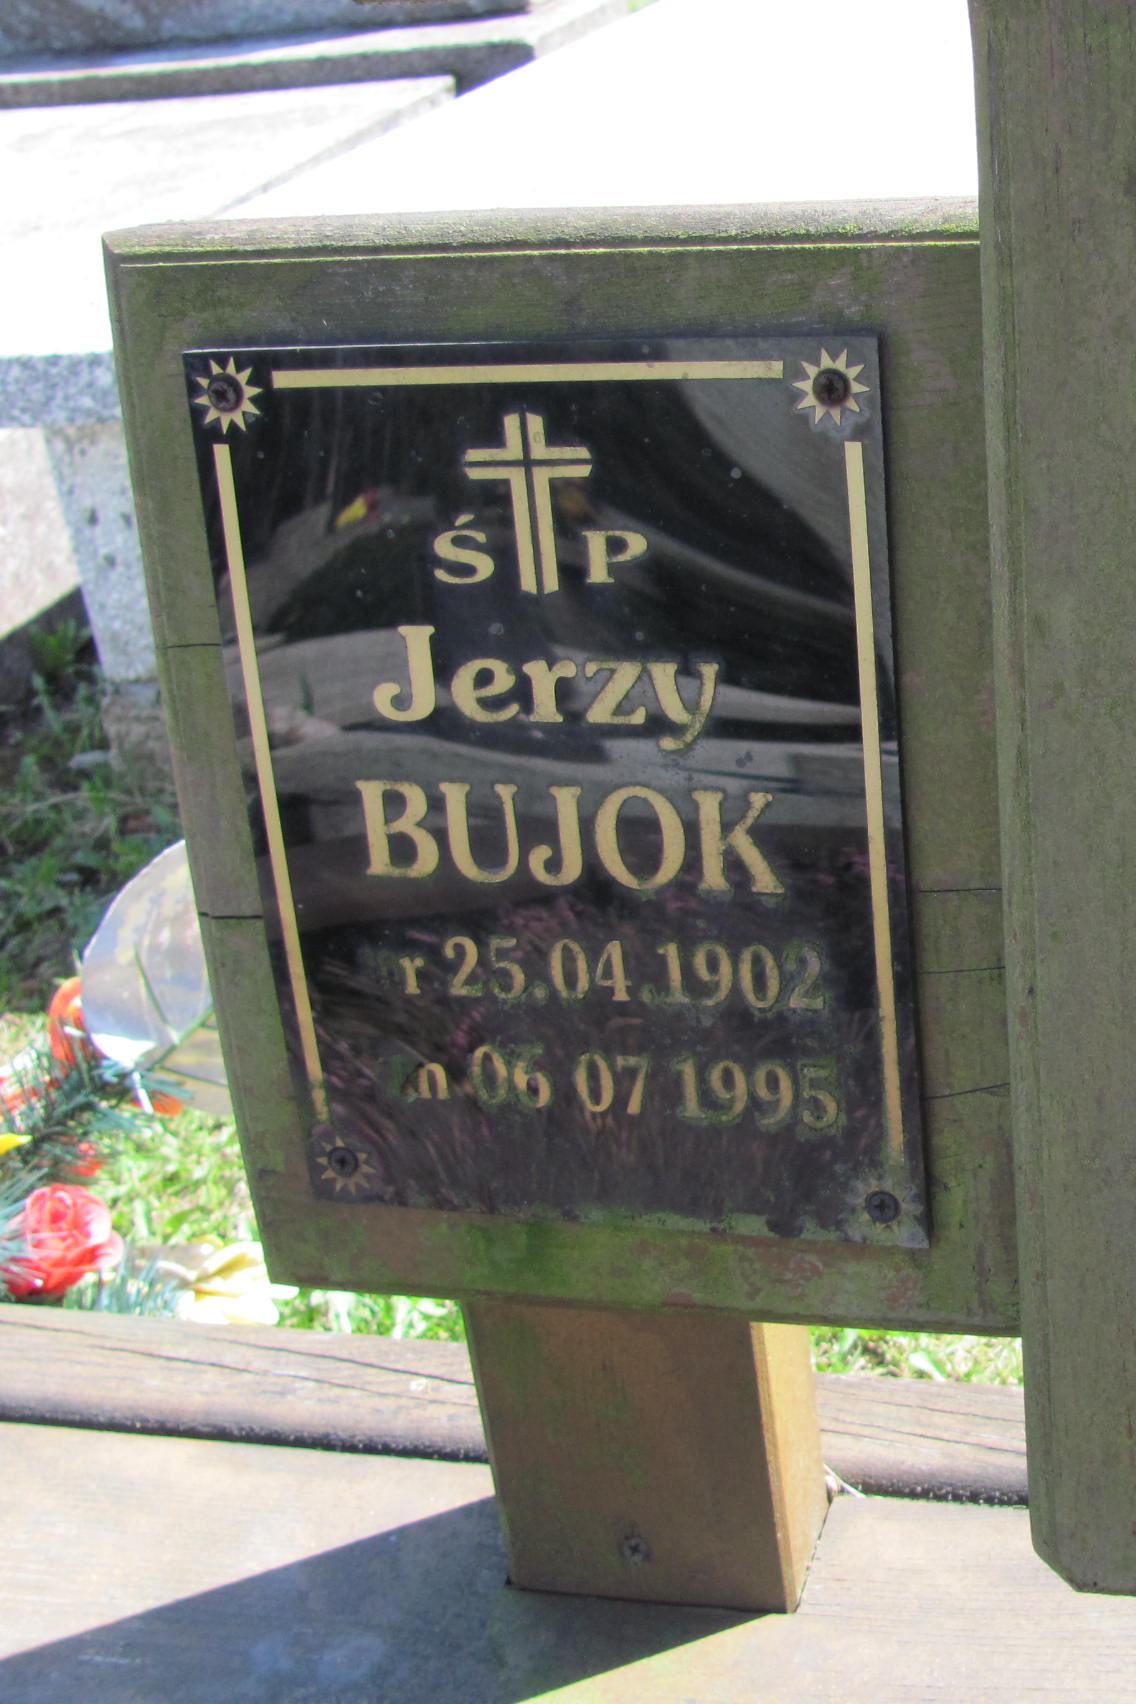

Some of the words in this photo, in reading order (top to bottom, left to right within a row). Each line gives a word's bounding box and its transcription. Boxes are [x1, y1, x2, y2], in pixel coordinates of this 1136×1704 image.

[433, 514, 495, 584] Ś
[581, 530, 648, 584] P
[372, 624, 720, 752] Jerzy
[355, 779, 785, 894] BUJOK
